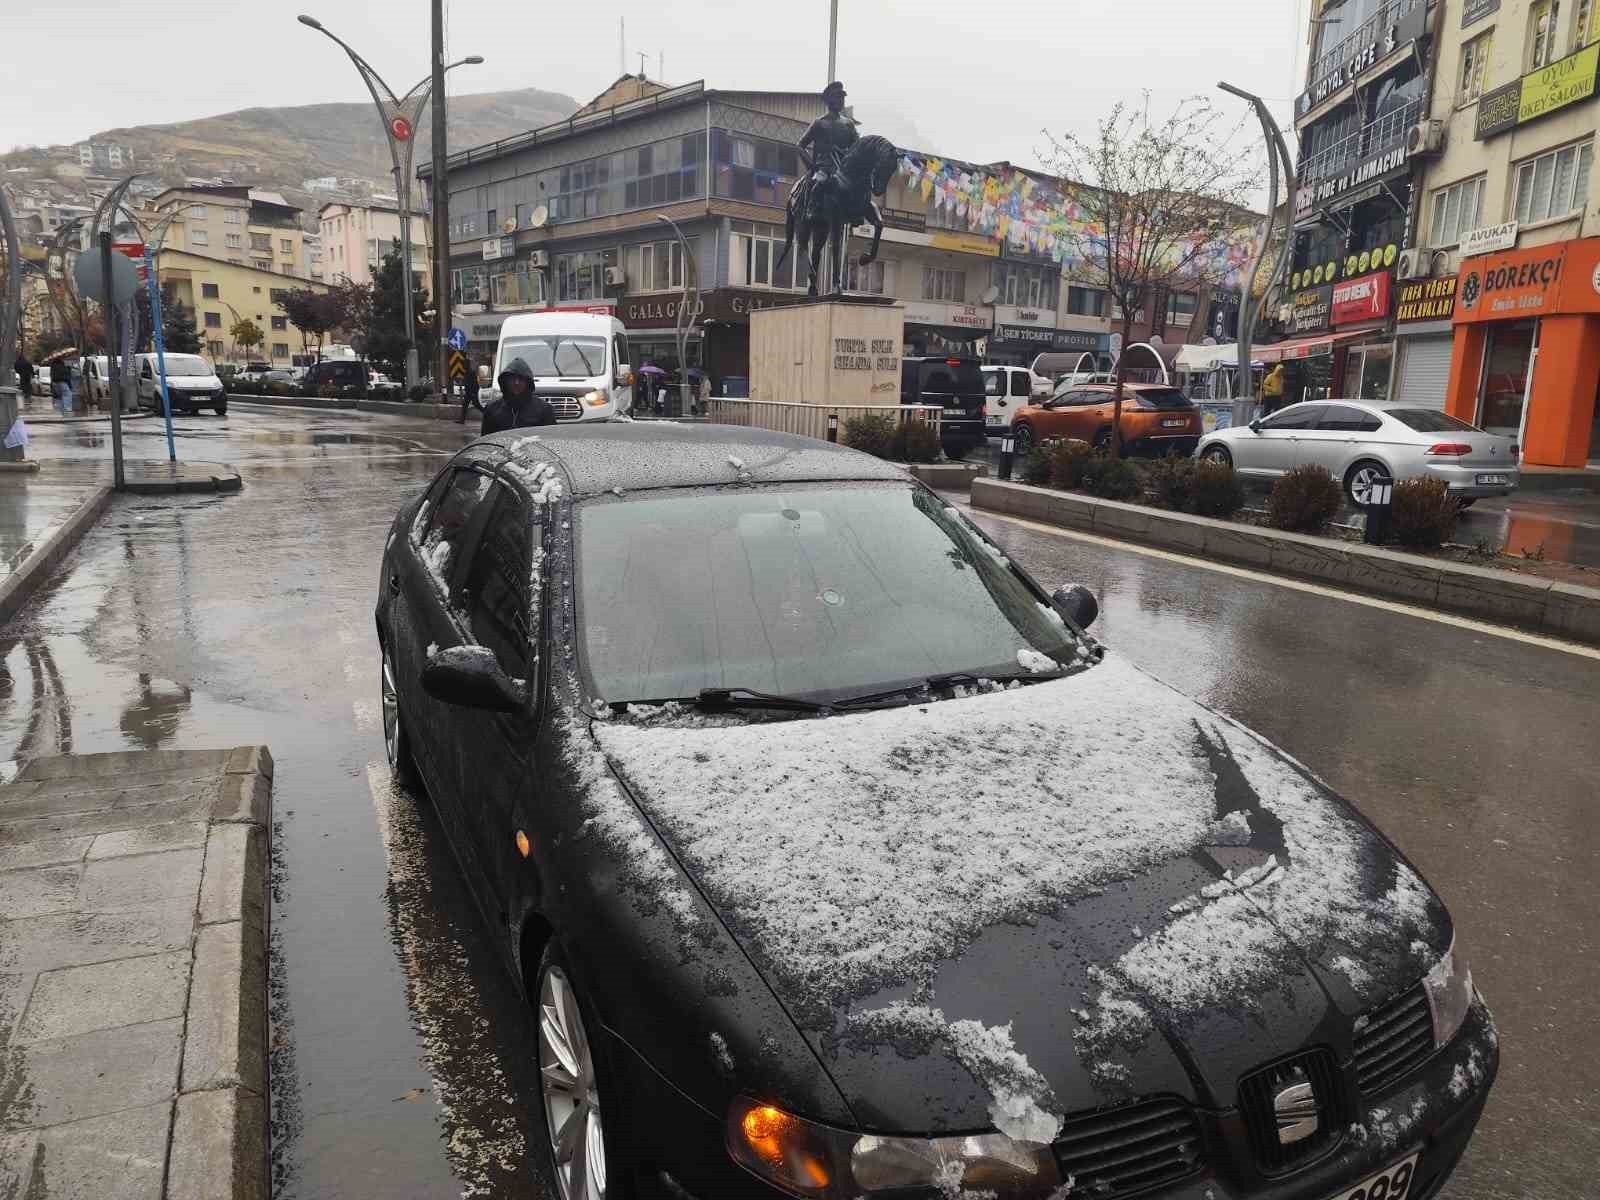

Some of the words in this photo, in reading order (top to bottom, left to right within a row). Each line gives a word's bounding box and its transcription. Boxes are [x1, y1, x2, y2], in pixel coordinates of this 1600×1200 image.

[1316, 68, 1344, 104] HAYAL
[1542, 54, 1577, 85] OYUN
[1520, 95, 1549, 118] OKEY
[1550, 77, 1592, 107] SALONU
[1350, 146, 1405, 187] LAHMACUN
[1470, 223, 1516, 241] AVUKAT
[1485, 249, 1565, 293] BÖREKÇİ
[629, 303, 663, 320] GALA
[1348, 1163, 1412, 1200] 99
